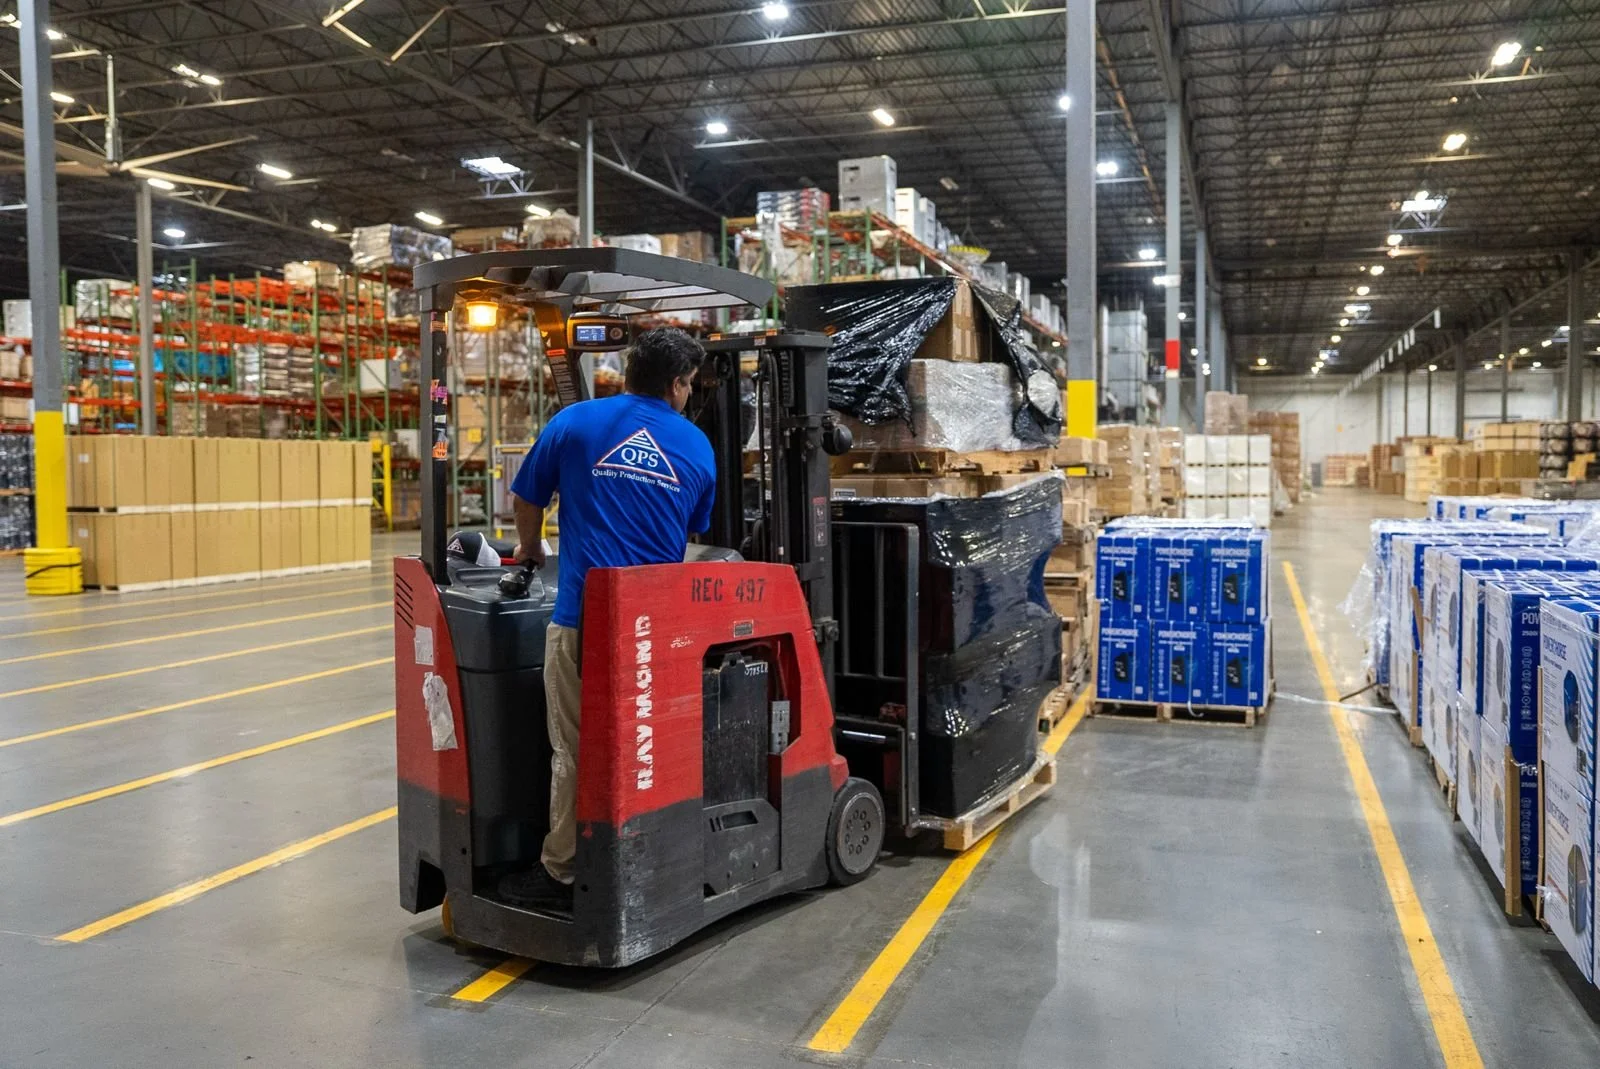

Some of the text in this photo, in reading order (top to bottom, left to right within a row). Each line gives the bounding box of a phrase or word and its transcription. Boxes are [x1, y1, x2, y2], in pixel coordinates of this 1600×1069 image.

[621, 447, 659, 468] QPS
[591, 468, 681, 493] Quality Production Services
[691, 577, 767, 602] REC 497
